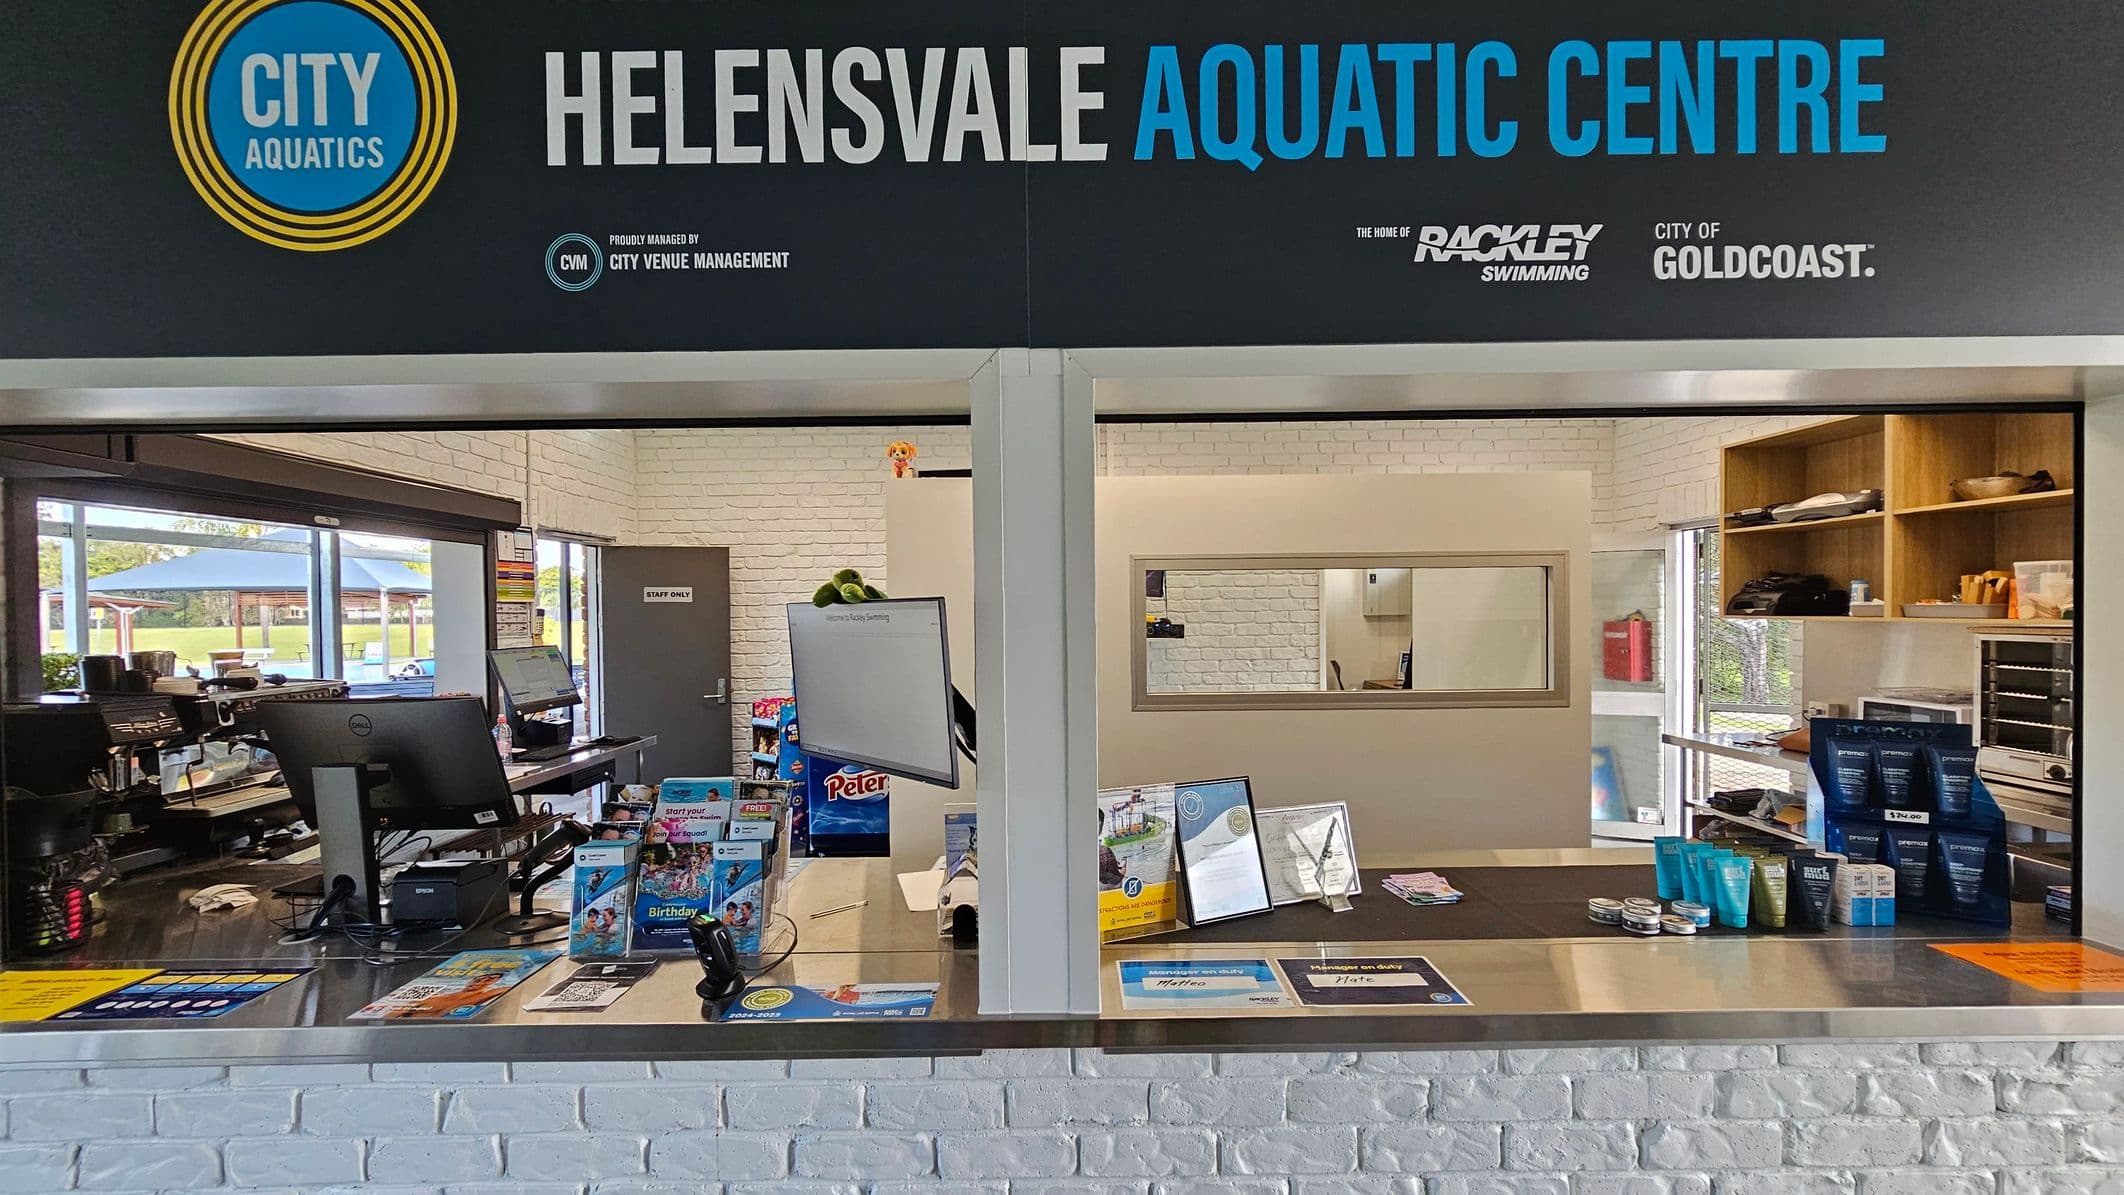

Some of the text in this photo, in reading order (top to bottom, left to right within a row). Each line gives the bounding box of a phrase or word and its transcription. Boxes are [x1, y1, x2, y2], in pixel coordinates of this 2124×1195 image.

[240, 52, 381, 131] CITY
[545, 39, 1888, 171] HELENSVALE AQUATIC CENTRE
[245, 136, 385, 171] AQUATICS
[1356, 226, 1411, 238] THE HOME OF
[1654, 222, 1721, 240] CITY OF
[609, 233, 699, 245] PROUDLY MANAGED BY
[1414, 223, 1604, 262] RACKLEY
[560, 254, 588, 271] CVM
[609, 251, 790, 270] CITY VENUE MANAGEMENT
[1481, 264, 1590, 282] SWIMMING
[825, 770, 889, 800] Peter
[687, 808, 706, 816] your
[1849, 834, 1880, 842] premax
[1898, 839, 1929, 847] premax
[1950, 843, 1986, 853] premax
[1803, 866, 1828, 874] surf
[1803, 872, 1831, 881] mud
[648, 906, 699, 918] Birthday
[1149, 969, 1200, 977] Manager
[1218, 968, 1244, 976] duty
[1376, 963, 1403, 971] duty
[1155, 978, 1207, 988] Matteo
